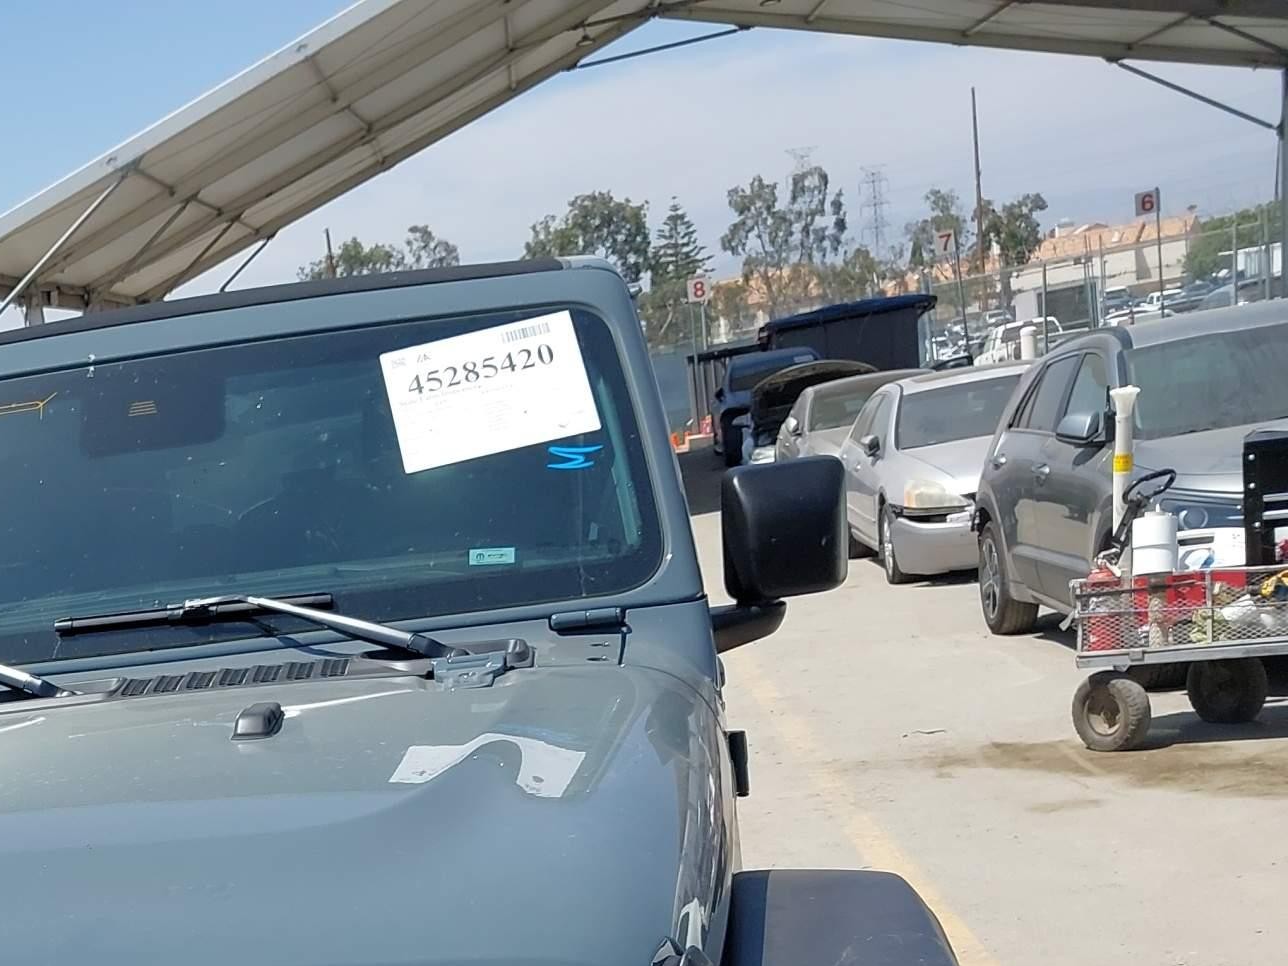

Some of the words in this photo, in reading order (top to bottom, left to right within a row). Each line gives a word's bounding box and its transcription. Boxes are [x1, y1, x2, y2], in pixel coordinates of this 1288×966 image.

[1142, 193, 1154, 211] 6
[938, 232, 952, 252] 7
[694, 281, 706, 298] 8
[408, 343, 554, 395] 45285420
